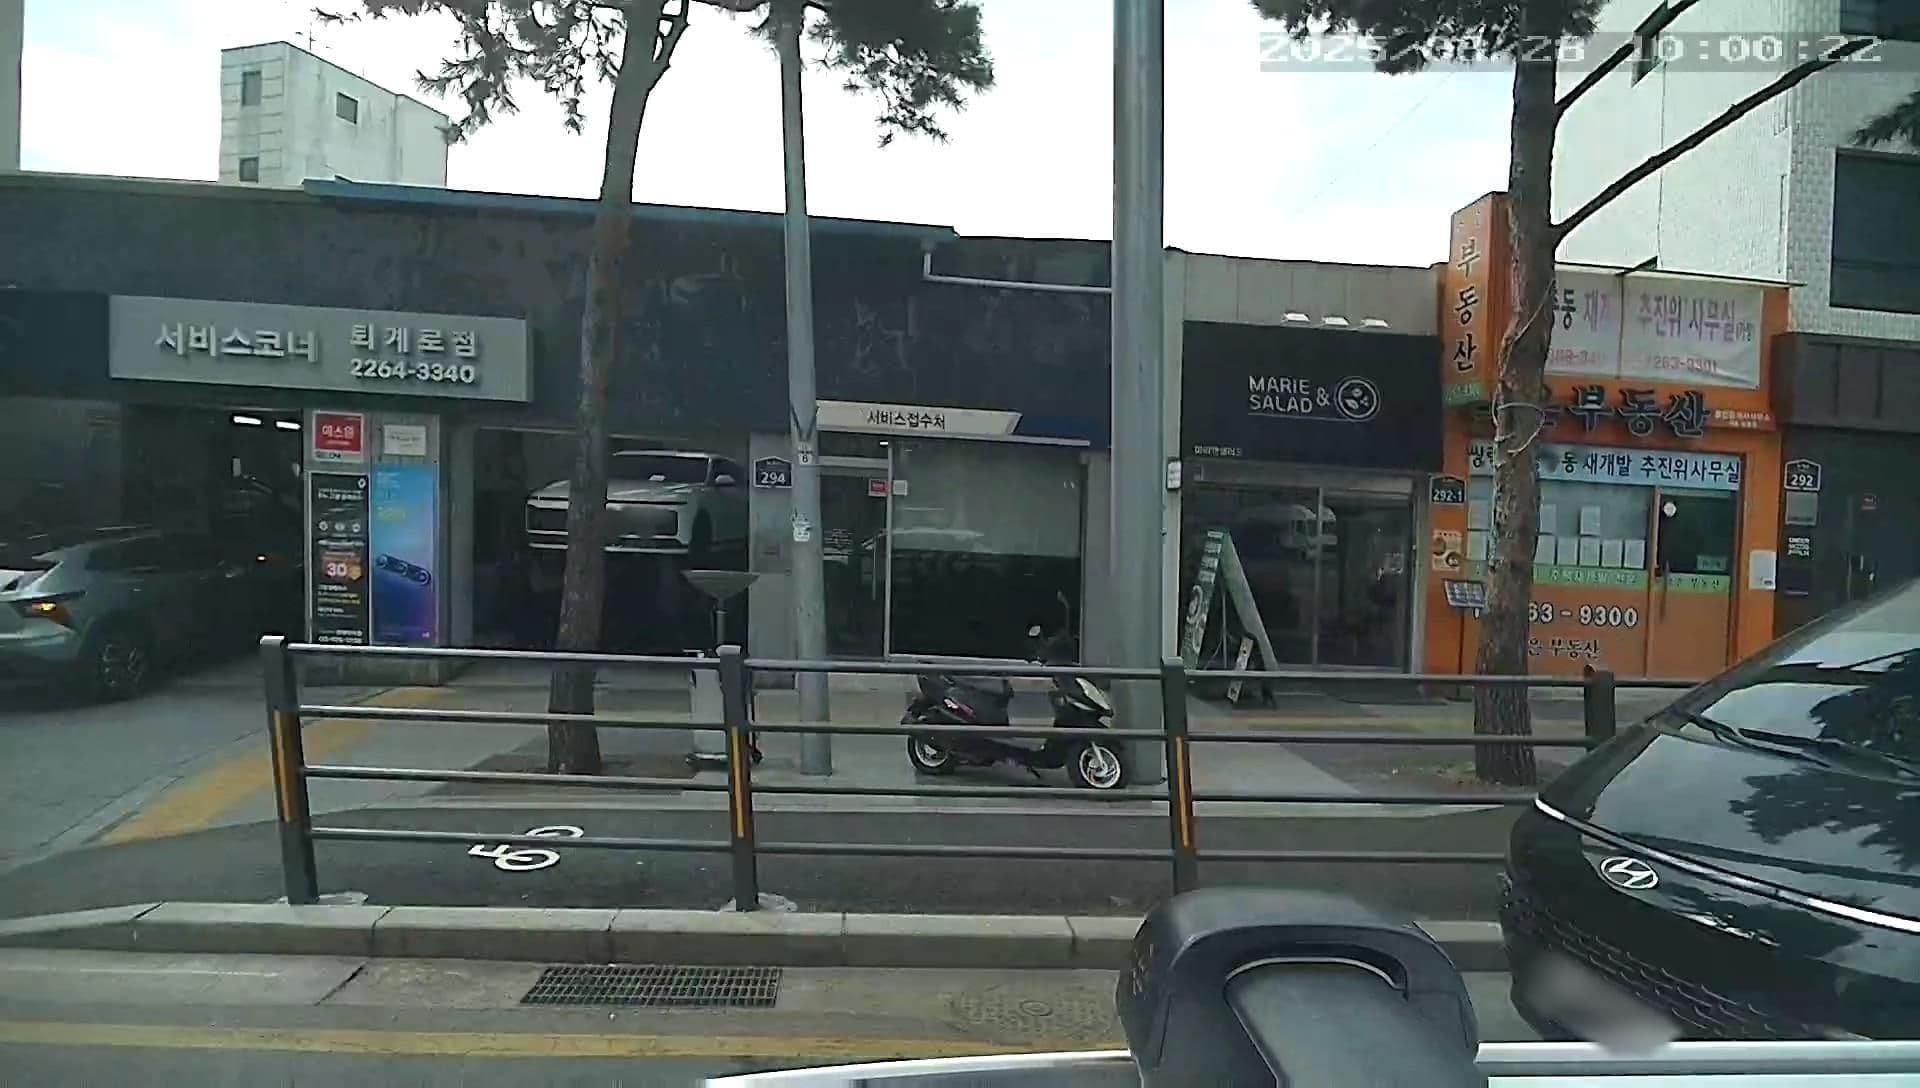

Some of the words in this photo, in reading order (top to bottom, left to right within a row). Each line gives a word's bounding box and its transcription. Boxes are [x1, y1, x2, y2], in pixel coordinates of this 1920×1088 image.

[1453, 237, 1481, 372] 부동산
[156, 321, 320, 361] 서비스코너
[349, 357, 476, 384] 2264-3340
[1248, 375, 1310, 395] MARIE
[1248, 394, 1313, 414] SALAD
[1316, 387, 1331, 407] &
[1568, 385, 1709, 438] 부동산
[866, 409, 946, 430] 서비스접수처
[760, 471, 786, 485] 294
[1790, 473, 1814, 487] 292
[1432, 488, 1463, 503] 292-1
[1550, 638, 1601, 660] 부동산
